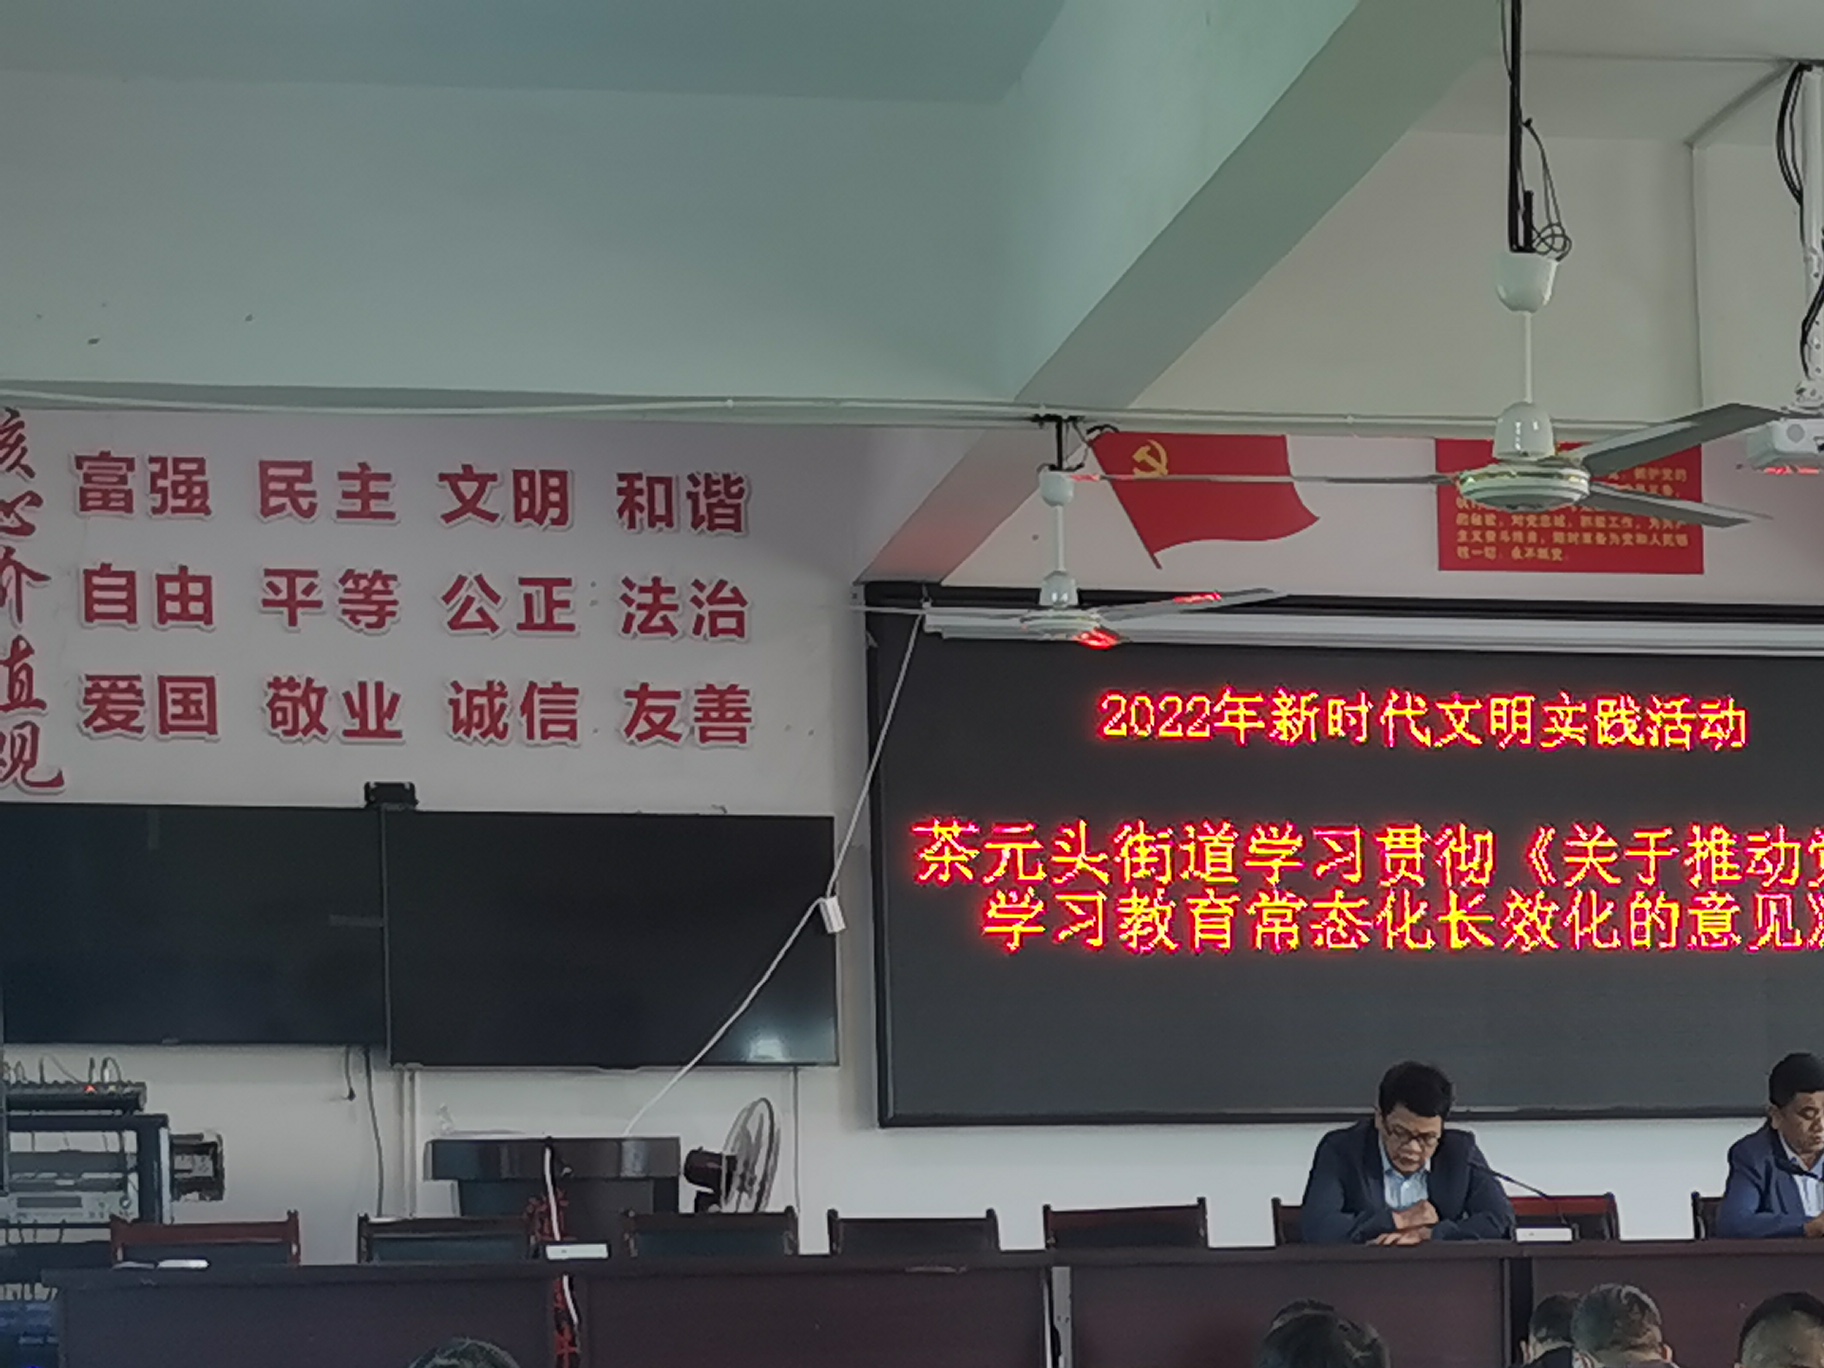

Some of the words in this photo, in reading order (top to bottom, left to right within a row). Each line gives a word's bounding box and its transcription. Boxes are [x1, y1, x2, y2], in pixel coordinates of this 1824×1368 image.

[75, 451, 212, 516] 富强
[259, 460, 397, 523] 民主
[438, 465, 570, 528] 文明
[616, 471, 747, 533] 和谐
[82, 564, 215, 627] 自由
[261, 568, 400, 631] 平等
[441, 574, 577, 635] 公正
[620, 576, 749, 639] 法治
[82, 674, 219, 737] 爱国
[266, 677, 403, 742] 敬业
[449, 681, 581, 743] 诚信
[624, 682, 754, 746] 友善
[1098, 685, 1748, 753] 2022年新时代文明实践活动
